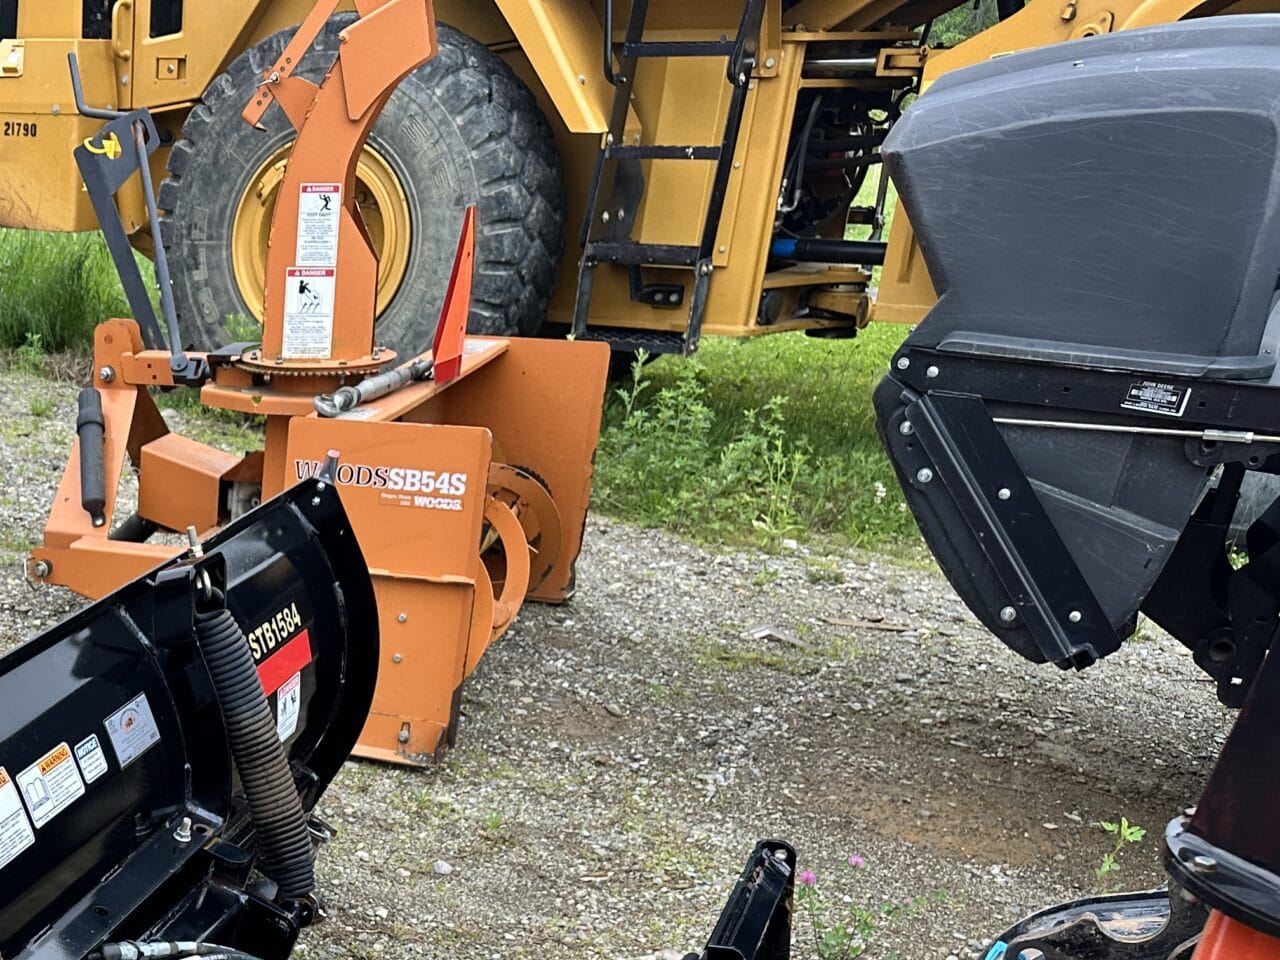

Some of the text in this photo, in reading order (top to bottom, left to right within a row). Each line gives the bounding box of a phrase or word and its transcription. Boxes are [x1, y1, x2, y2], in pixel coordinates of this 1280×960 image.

[4, 121, 37, 137] 21790
[294, 459, 468, 496] WODS SB54S
[248, 602, 302, 660] STB1584
[45, 747, 68, 767] WARNING
[78, 738, 98, 758] NOTICE
